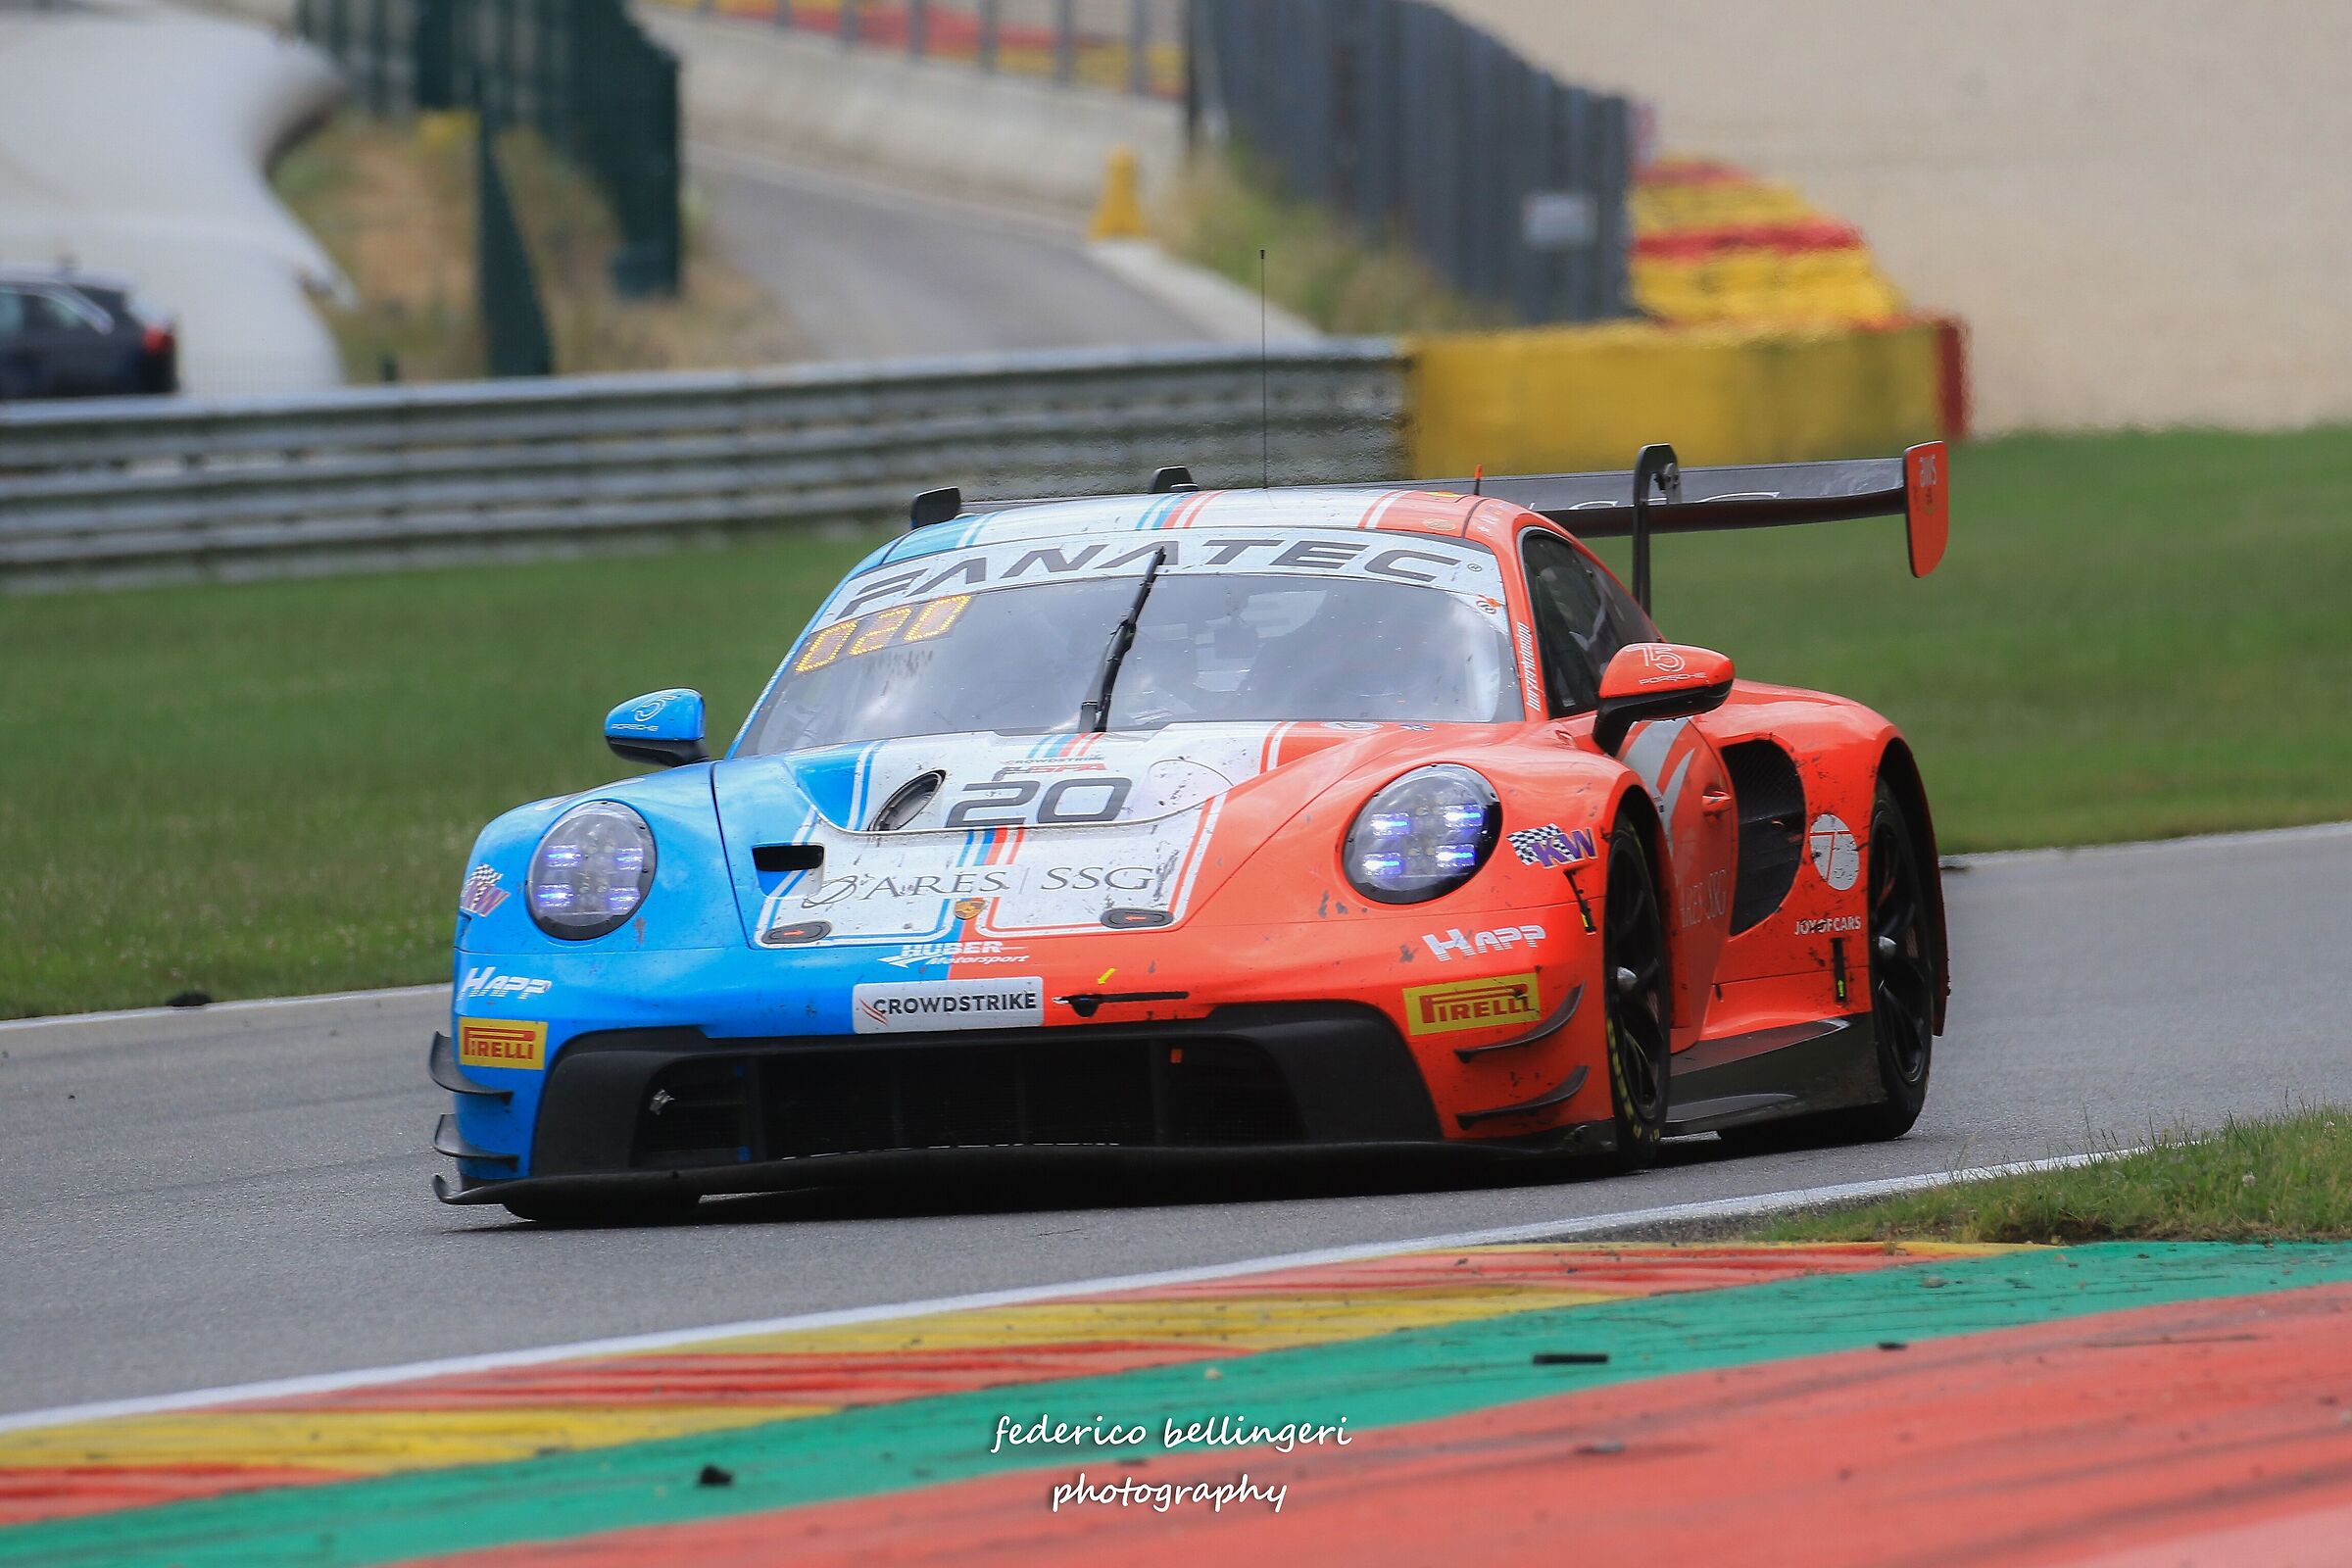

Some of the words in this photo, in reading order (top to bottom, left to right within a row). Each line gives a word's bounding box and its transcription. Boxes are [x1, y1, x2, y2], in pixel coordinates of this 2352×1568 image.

[835, 540, 1461, 621] FANATEC
[794, 594, 971, 672] 020
[1626, 644, 1686, 672] 75
[946, 777, 1133, 828] 20
[1529, 827, 1599, 868] KW
[861, 870, 1009, 902] ARES
[1040, 866, 1156, 892] SSG
[902, 940, 1005, 958] HUBER
[872, 992, 1037, 1015] CROWDSTRIKE
[1419, 983, 1536, 1025] PIRELLI
[464, 1027, 537, 1060] PIRELLI
